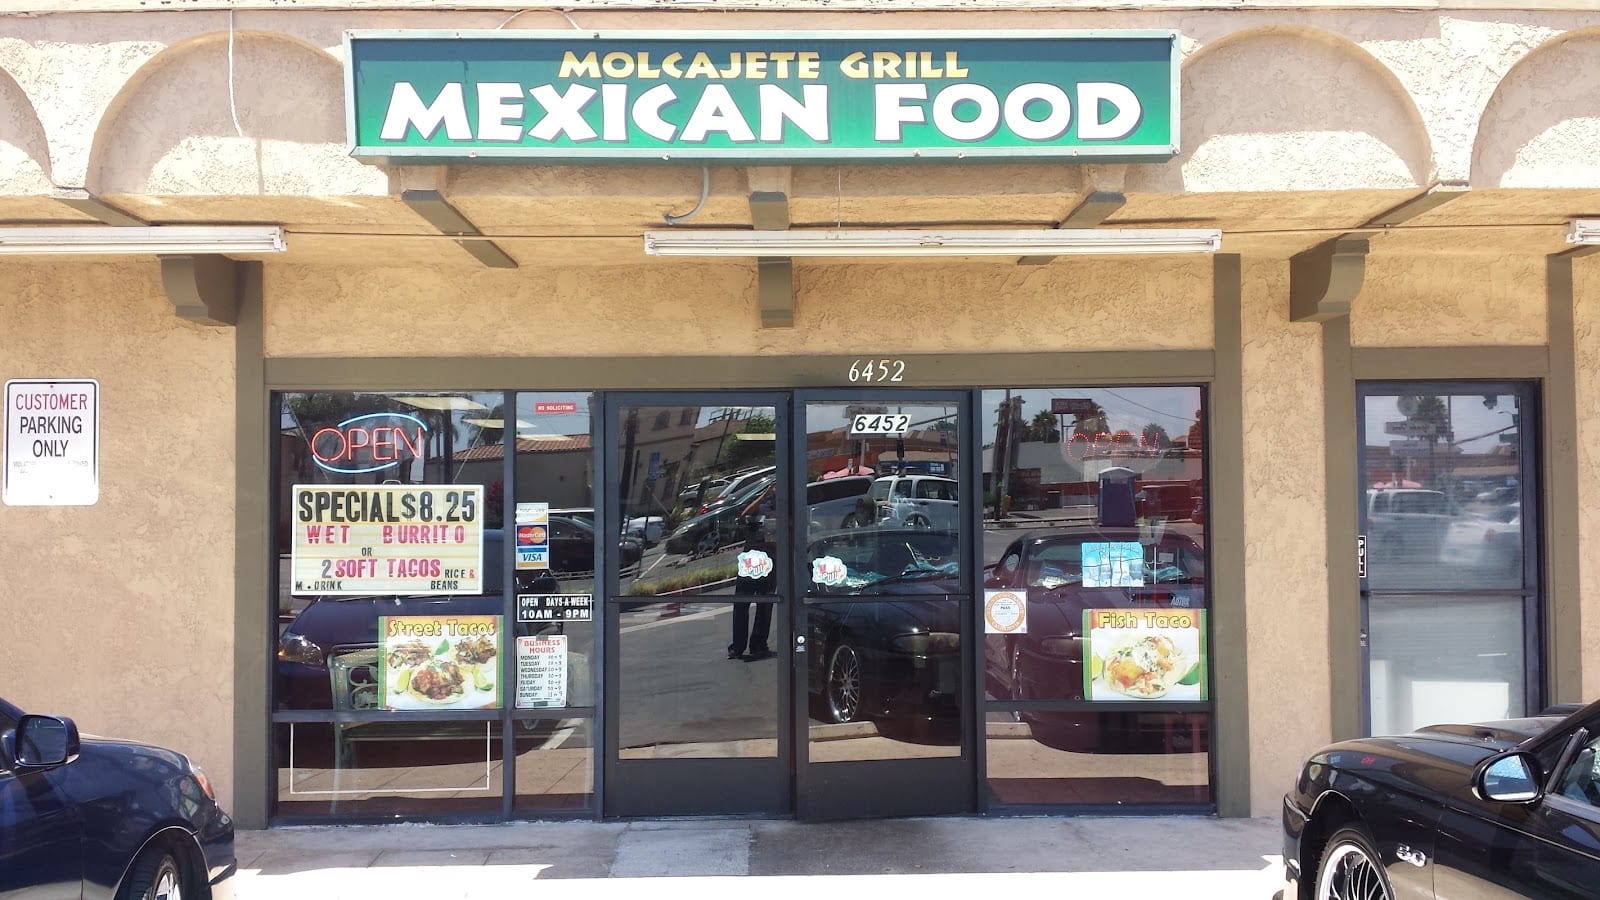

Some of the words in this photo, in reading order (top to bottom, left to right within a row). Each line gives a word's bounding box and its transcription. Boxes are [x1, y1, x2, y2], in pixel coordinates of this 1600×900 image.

[558, 50, 820, 79] MOLCAJETE
[840, 50, 970, 79] GRILL
[379, 81, 831, 144] MEXICAN
[874, 80, 1144, 143] FOOD
[848, 359, 905, 382] 6452
[15, 393, 88, 411] CUSTOMER
[20, 416, 82, 434] PARKING
[854, 415, 908, 432] 6452
[33, 440, 69, 457] ONLY
[311, 426, 423, 462] OPEN
[1067, 431, 1159, 461] OPEN
[306, 525, 350, 544] WET
[382, 524, 465, 544] BURRITO
[361, 547, 372, 557] OR
[522, 553, 542, 562] VISA
[1357, 540, 1365, 573] PULL
[321, 559, 332, 579] 2
[335, 558, 378, 578] SOFT
[387, 558, 441, 578] TACOS
[445, 569, 466, 579] RICE
[469, 569, 476, 579] &
[430, 580, 459, 590] BEANS
[521, 597, 539, 607] OPEN
[521, 610, 553, 619] 10AM
[565, 609, 589, 618] 9PM
[1098, 612, 1138, 629] Fish
[1144, 612, 1192, 629] Taco
[389, 619, 442, 637] Street
[446, 619, 496, 636] Tacos
[524, 639, 561, 647] BUSINESS
